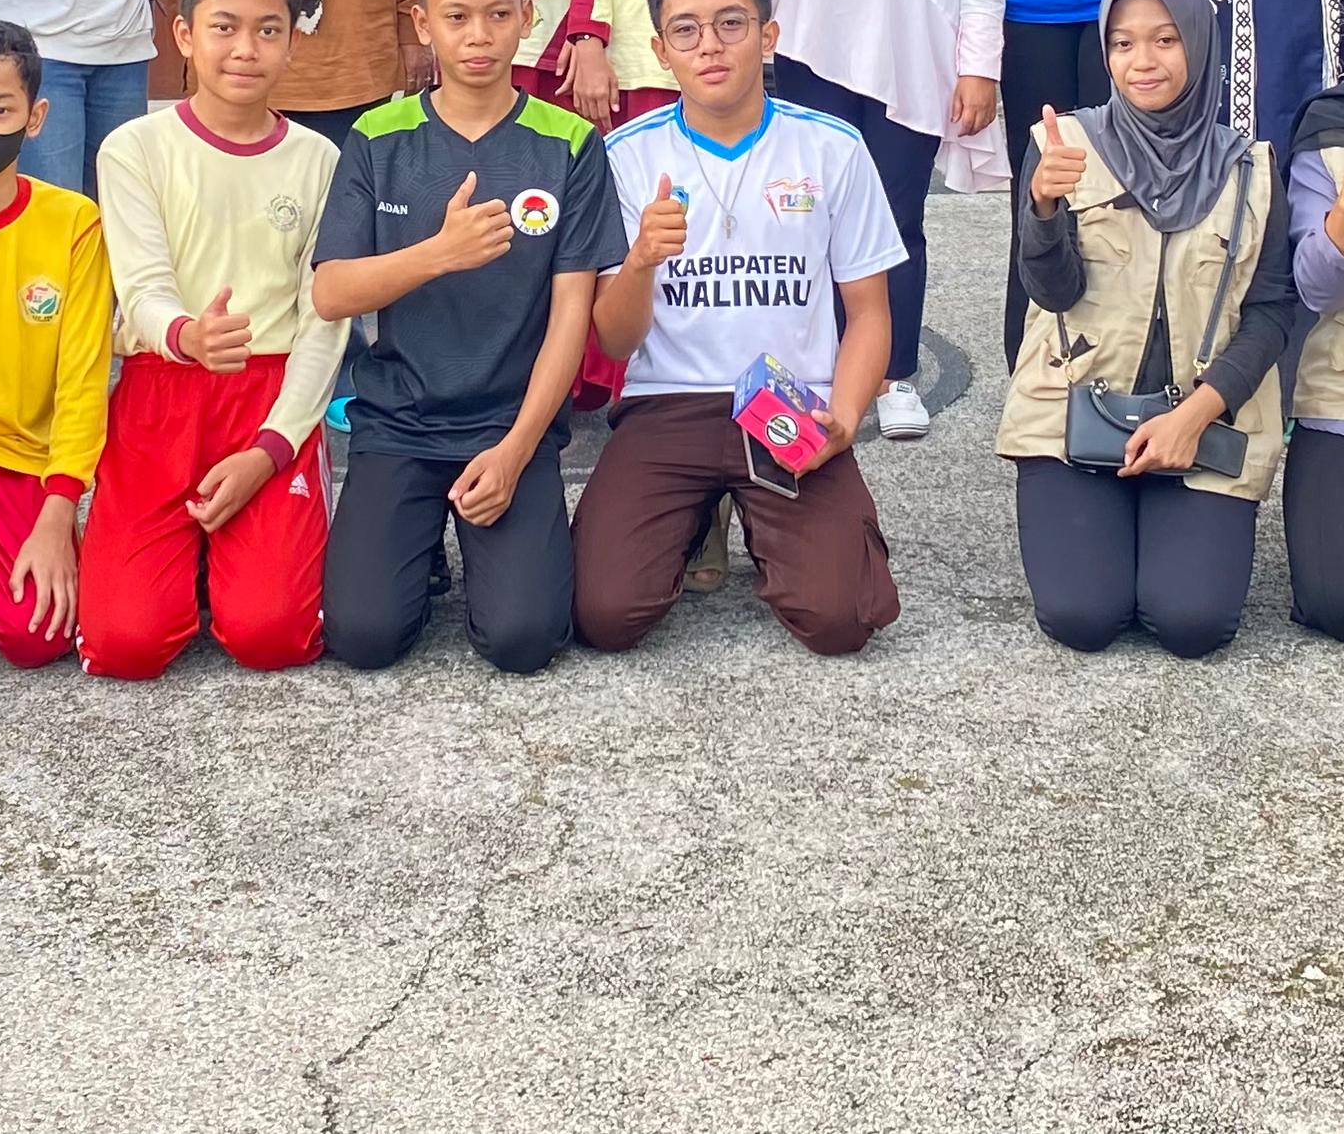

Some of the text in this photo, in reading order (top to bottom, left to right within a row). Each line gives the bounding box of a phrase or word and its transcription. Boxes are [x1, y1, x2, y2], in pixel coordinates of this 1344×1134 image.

[377, 201, 408, 215] ADAN
[668, 255, 806, 278] KABUPATEN
[661, 279, 812, 307] MALINAU
